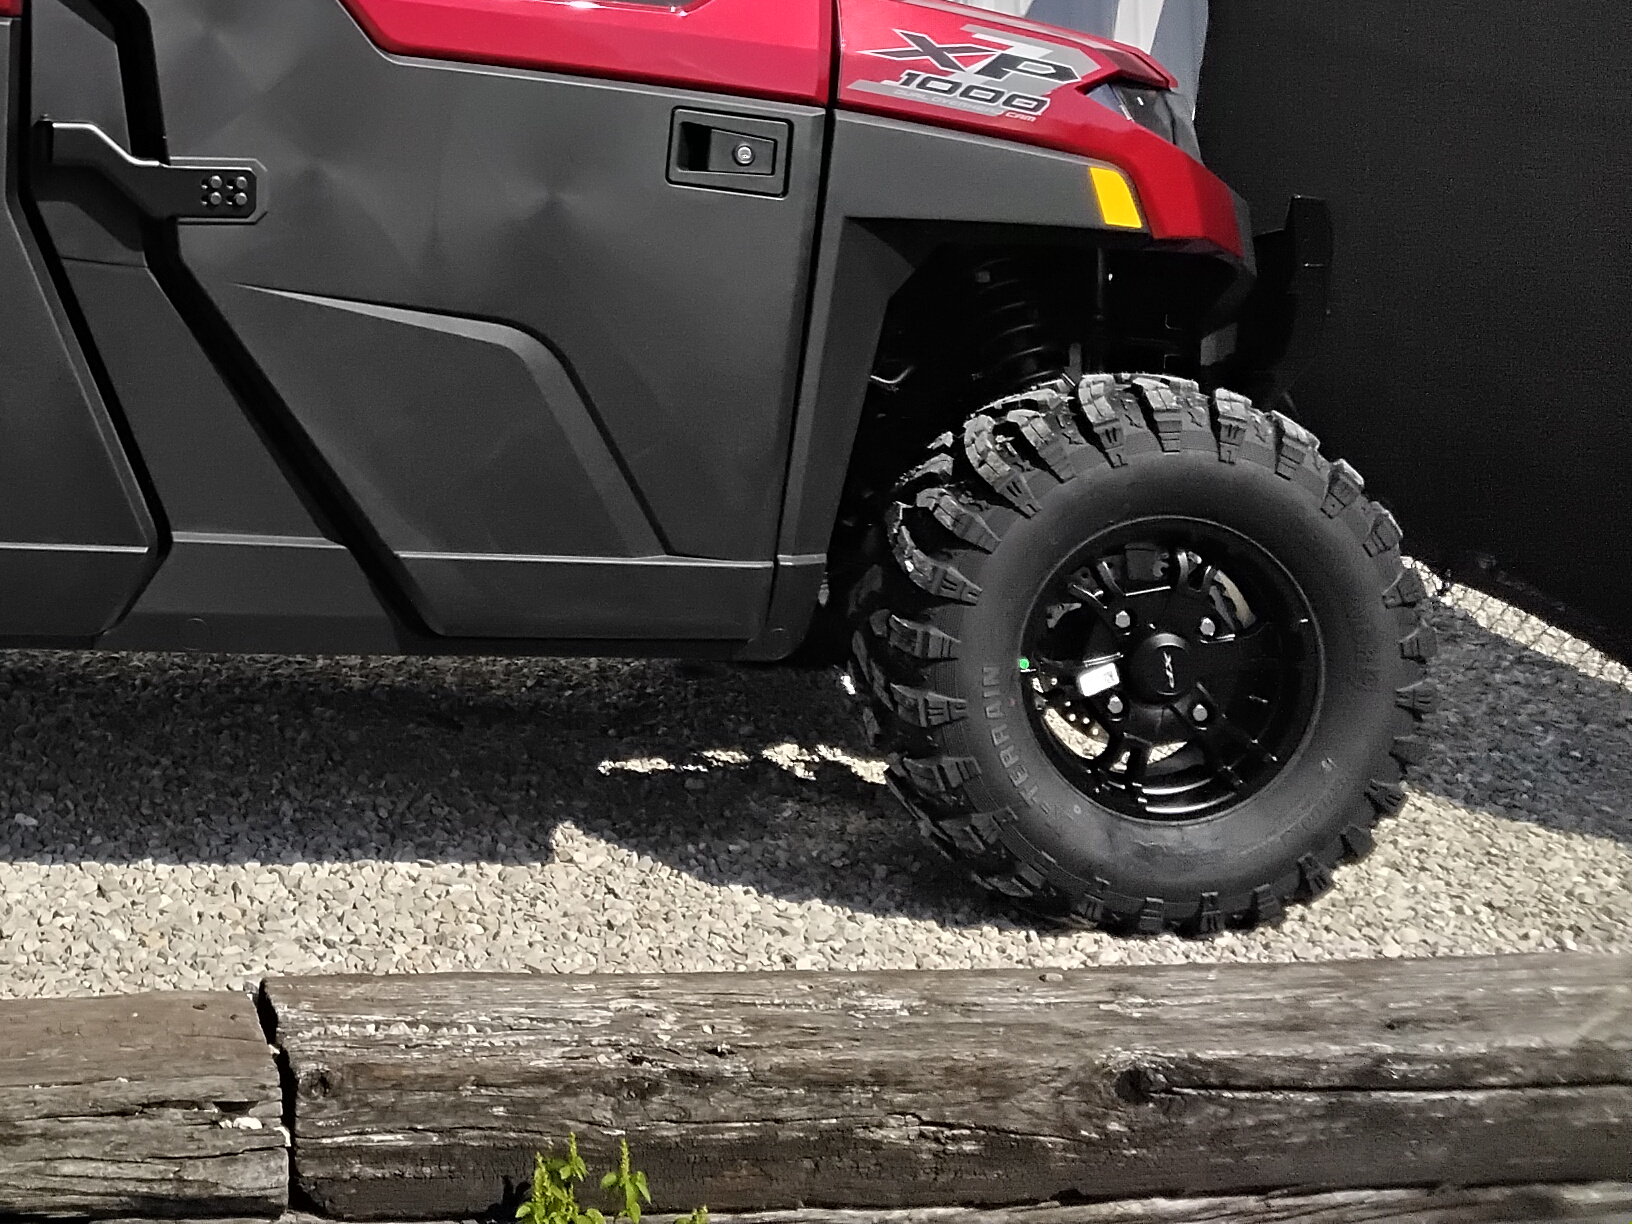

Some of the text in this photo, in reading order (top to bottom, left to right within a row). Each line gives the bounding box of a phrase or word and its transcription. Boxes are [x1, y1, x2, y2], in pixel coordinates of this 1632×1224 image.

[856, 28, 1081, 84] XP
[899, 69, 1051, 116] 1000
[1005, 110, 1037, 123] CAM
[982, 666, 1070, 833] -TERRAIN
